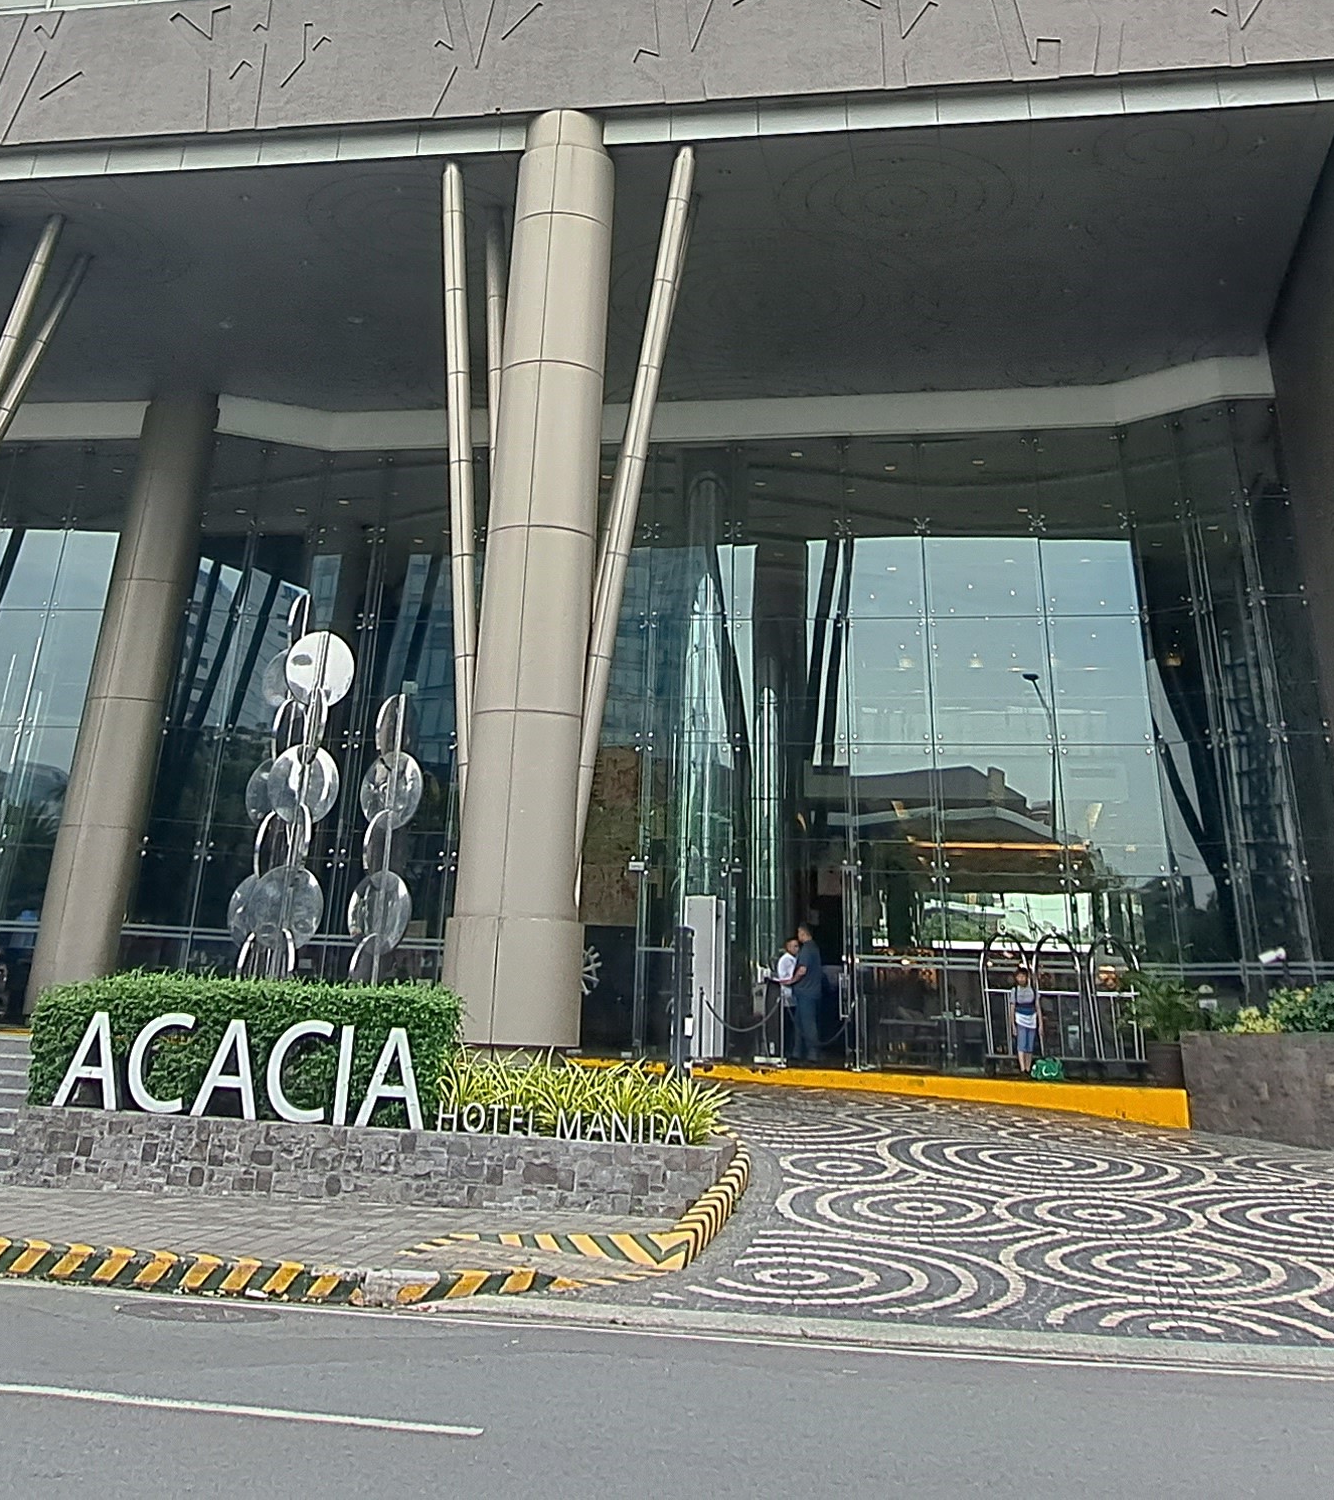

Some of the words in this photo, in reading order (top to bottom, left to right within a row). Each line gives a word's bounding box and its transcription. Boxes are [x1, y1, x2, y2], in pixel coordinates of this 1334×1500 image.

[52, 1011, 423, 1130] ACACIA
[436, 1100, 540, 1138] HOTEL
[555, 1107, 686, 1145] MANILA
